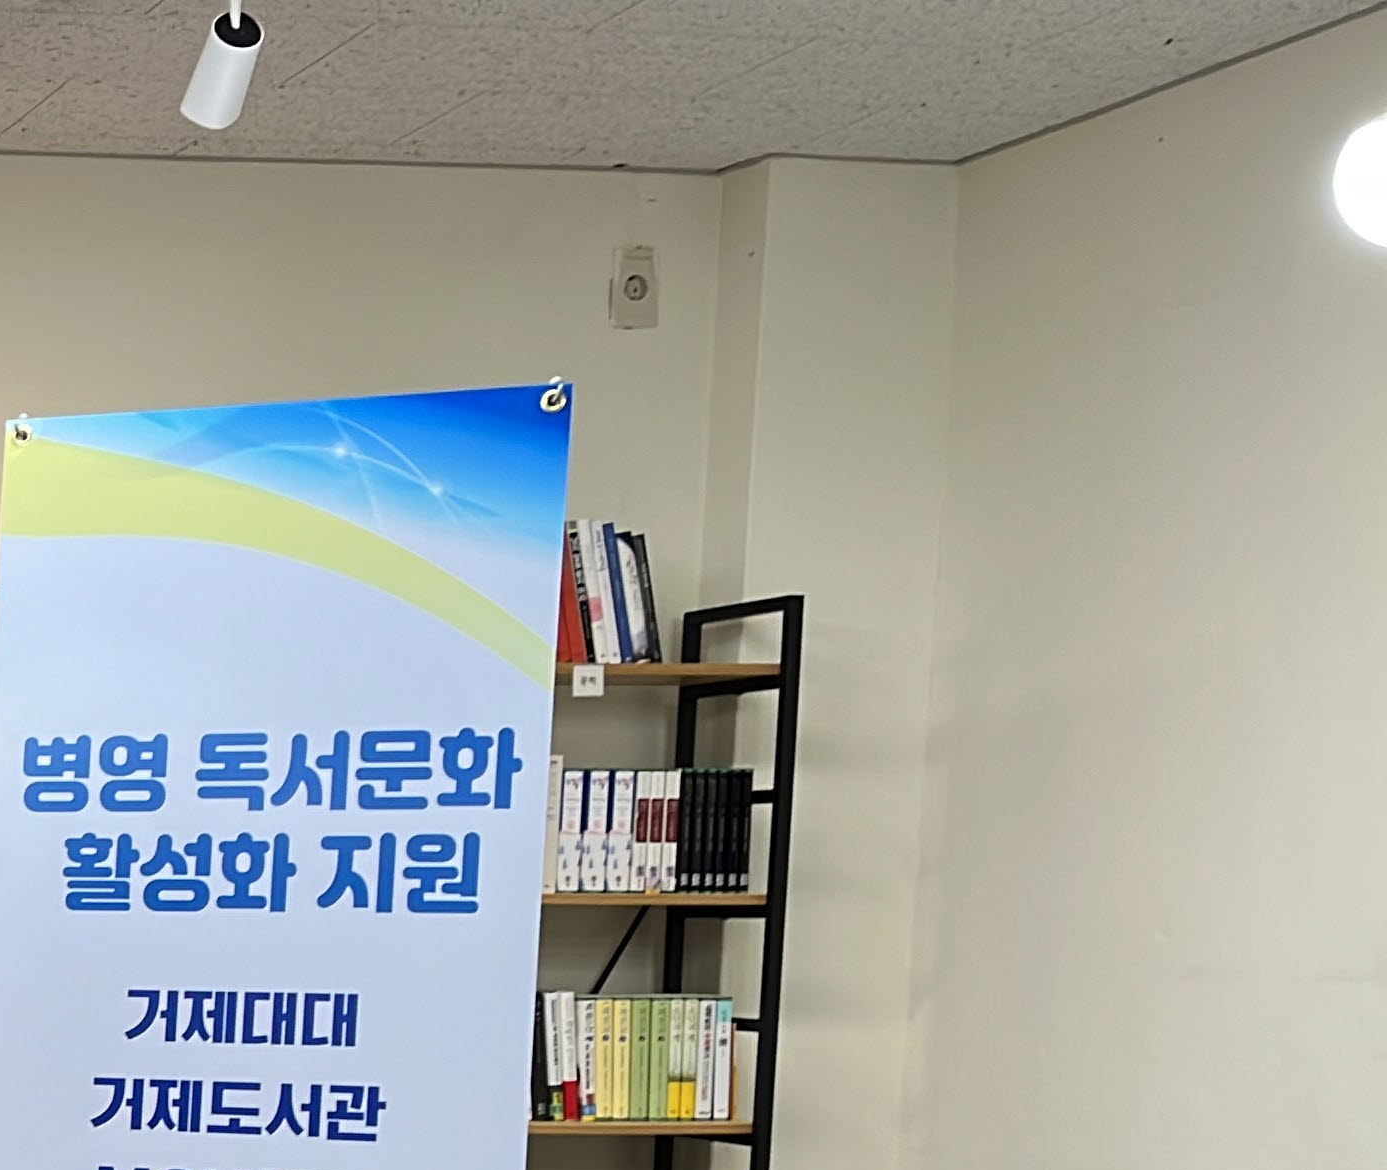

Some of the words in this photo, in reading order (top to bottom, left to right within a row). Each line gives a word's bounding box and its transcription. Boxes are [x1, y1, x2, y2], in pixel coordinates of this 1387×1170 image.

[22, 734, 168, 812] 병영
[193, 727, 523, 812] 독서문화
[63, 833, 297, 913] 활성화
[316, 832, 480, 915] 지원
[125, 986, 359, 1049] 거제대대
[90, 1077, 386, 1143] 거제도서관
